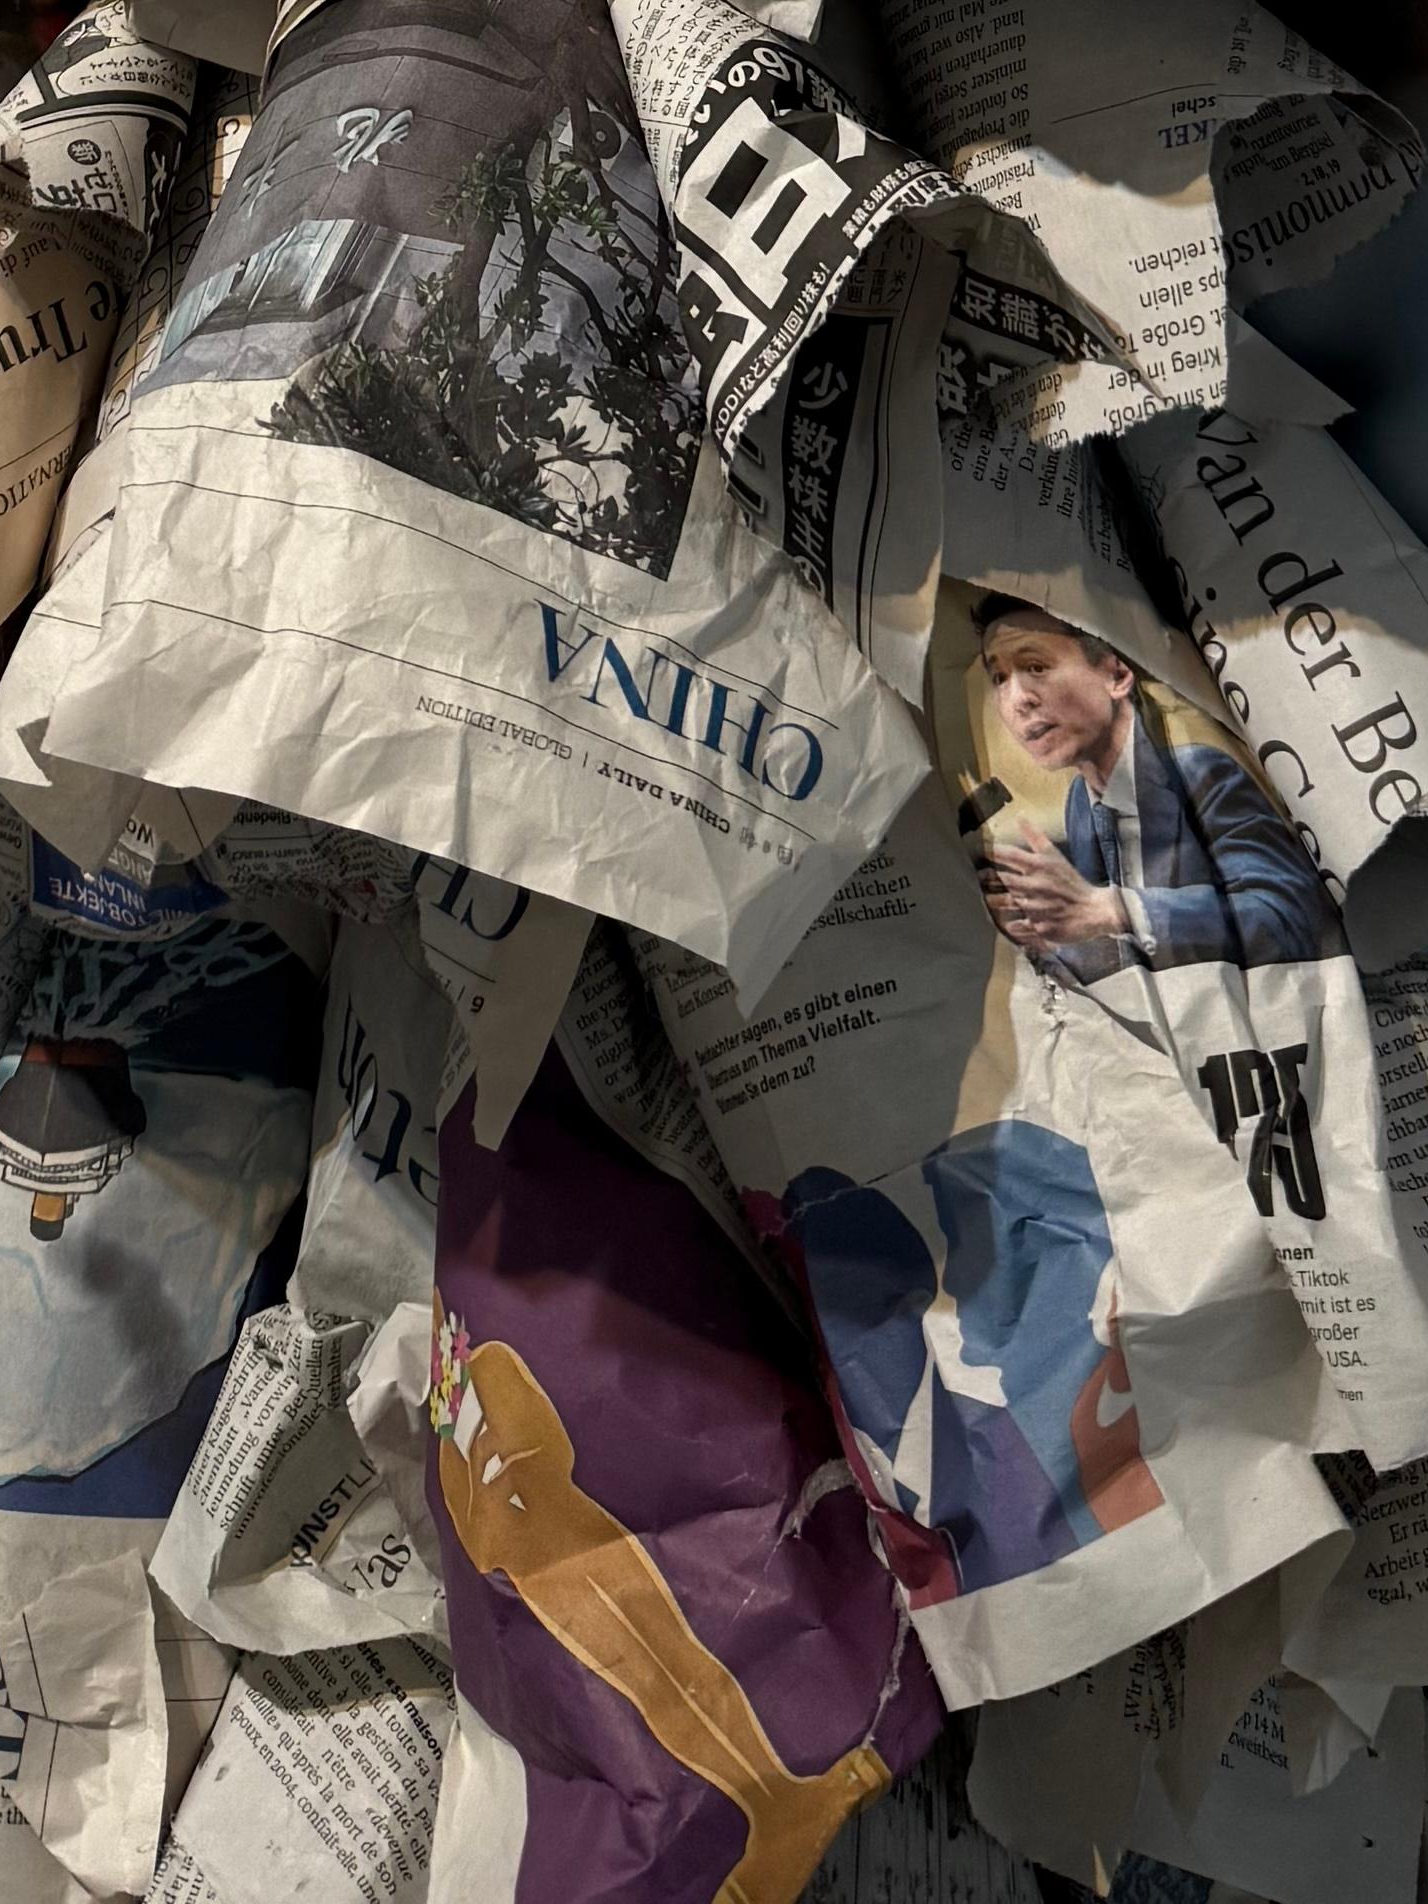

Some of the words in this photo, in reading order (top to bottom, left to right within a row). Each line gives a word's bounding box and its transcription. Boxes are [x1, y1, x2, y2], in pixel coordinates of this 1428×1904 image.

[1128, 239, 1206, 273] reichen.
[1139, 280, 1193, 310] allein
[1141, 314, 1205, 347] Große
[1170, 346, 1221, 373] Krieg
[1107, 367, 1146, 391] der
[1258, 552, 1360, 690] der
[415, 695, 496, 732] EDITION
[501, 602, 834, 800] CHINA
[499, 719, 572, 760] GLOBAL
[596, 761, 663, 799] DAILY
[669, 790, 730, 834] CHINA
[844, 978, 897, 1003] einen
[757, 1034, 808, 1063] Thema
[807, 1008, 880, 1042] Vielfalt.
[1325, 1350, 1368, 1368] USA.
[355, 1720, 401, 1773] gestion
[403, 1700, 443, 1760] maison
